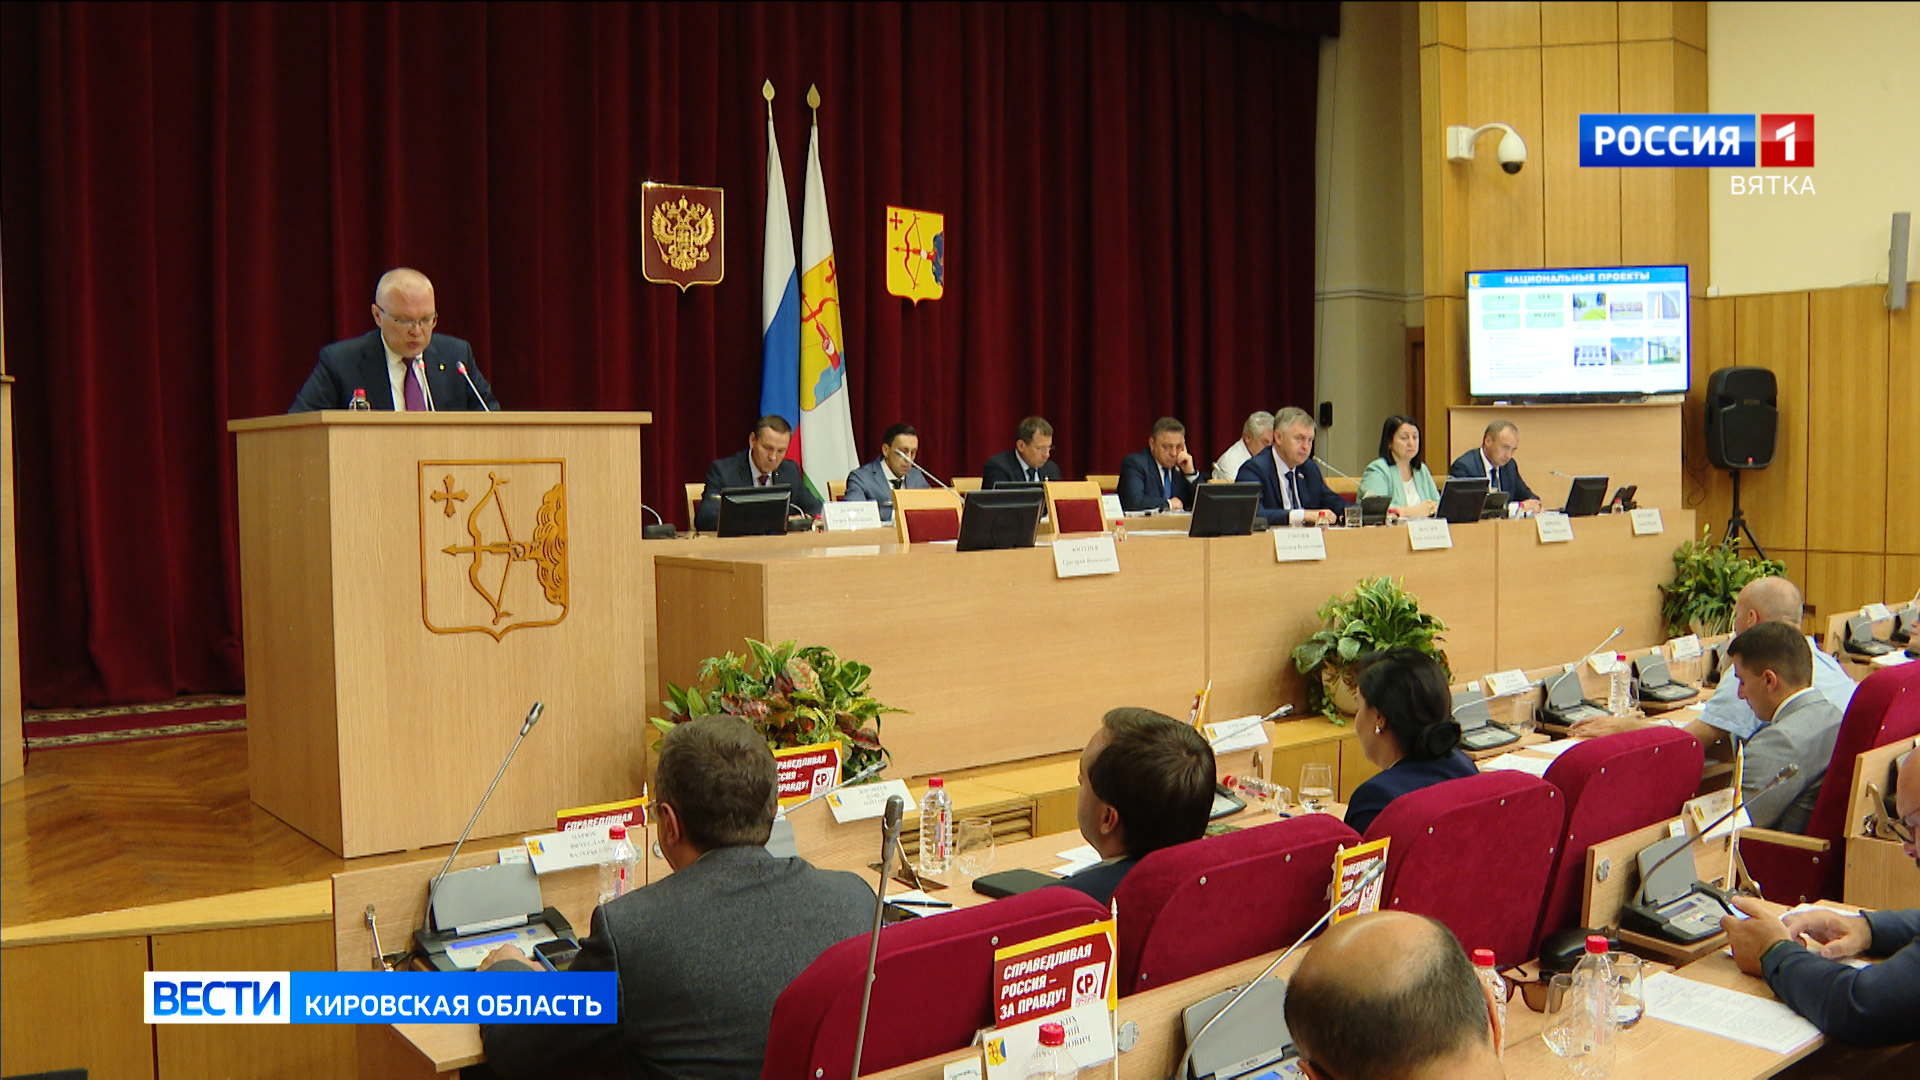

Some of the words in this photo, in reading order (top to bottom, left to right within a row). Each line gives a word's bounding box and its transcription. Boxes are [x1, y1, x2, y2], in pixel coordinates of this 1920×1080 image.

[1504, 273, 1596, 286] НАЦИОНАЛЬНЫЕ
[1598, 271, 1650, 282] ПРОЕКТЫ
[777, 754, 827, 770] РАВЕДЛИВАЯ
[1003, 943, 1093, 980] СПРАВЕДЛИВАЯ
[1000, 974, 1047, 1000] РОССИЯ
[1076, 972, 1094, 995] СР
[1000, 1003, 1015, 1020] ЗА
[1017, 987, 1067, 1014] ПРАВДУ!
